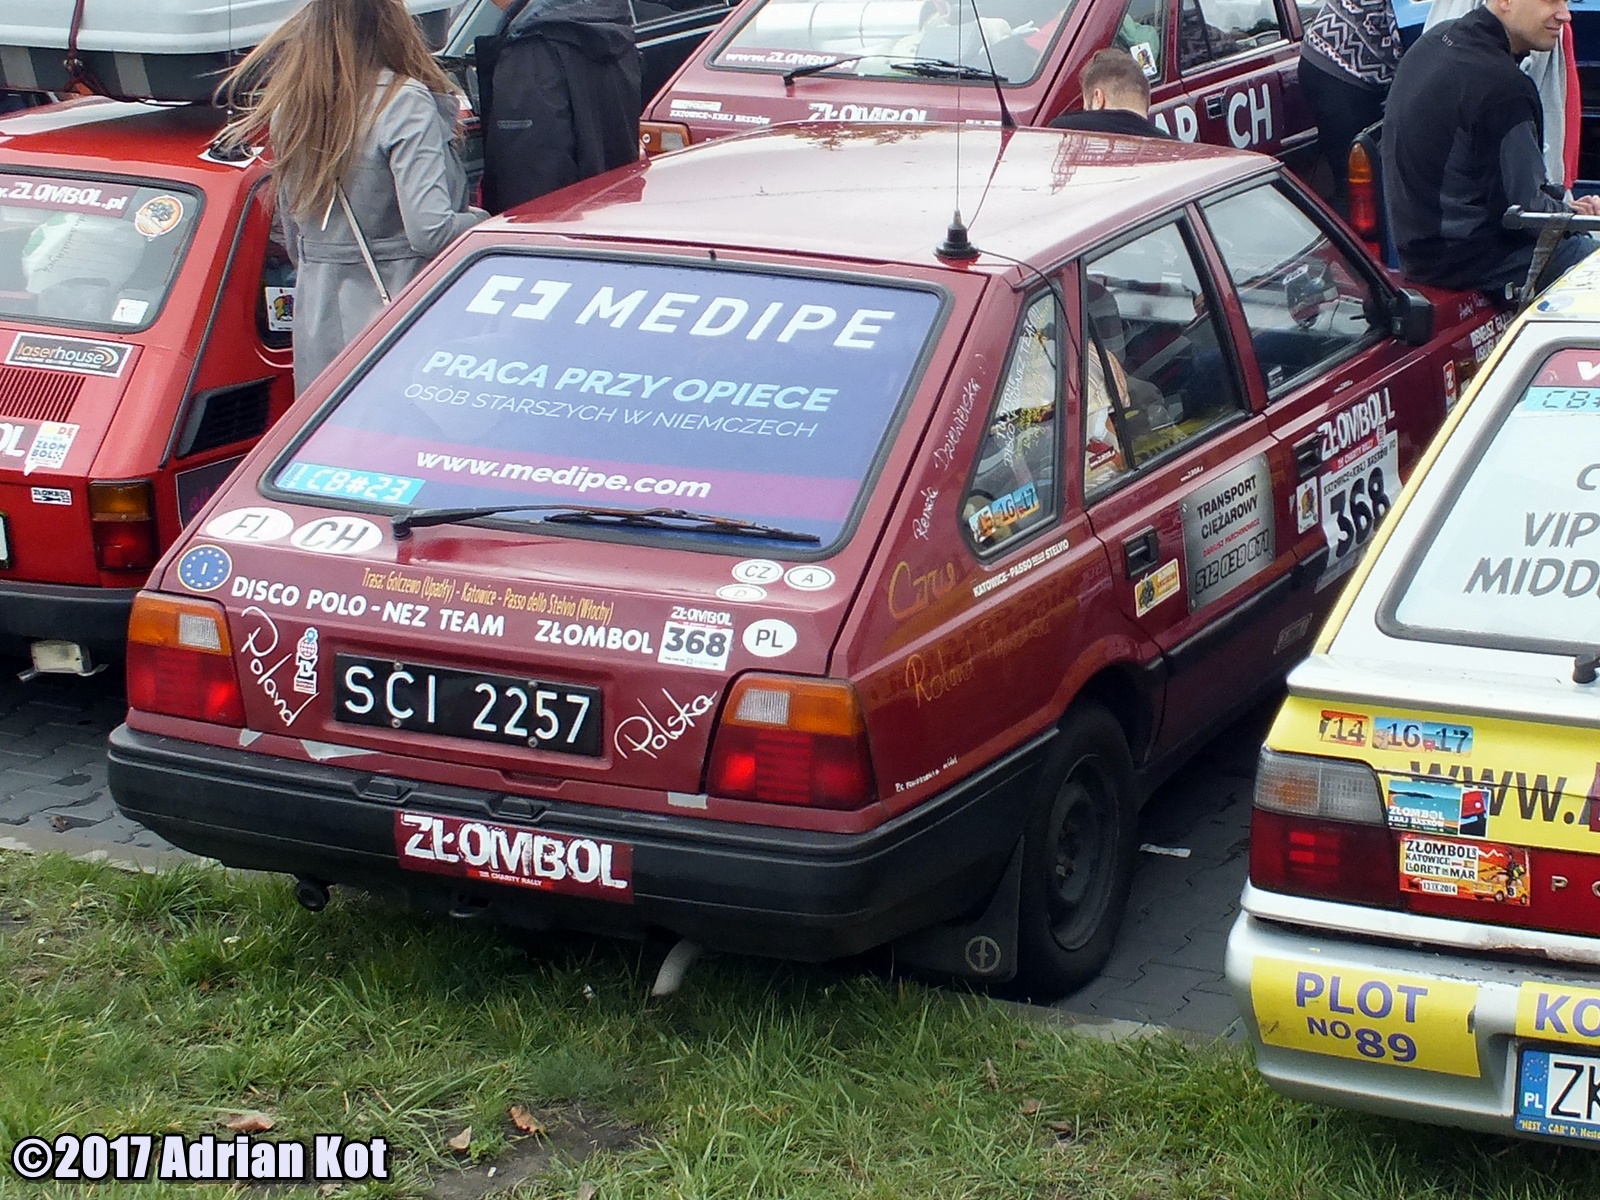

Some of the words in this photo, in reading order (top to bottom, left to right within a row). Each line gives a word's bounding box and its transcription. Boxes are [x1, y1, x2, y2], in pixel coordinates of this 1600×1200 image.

[1228, 83, 1273, 149] CH
[575, 285, 896, 350] MEDIPE
[17, 342, 105, 364] laserhouse
[421, 350, 554, 388] PRACA
[554, 366, 669, 399] PRZY
[671, 378, 840, 412] OPIECE
[403, 381, 471, 405] OSÓB
[471, 392, 617, 425] STARSZYCH
[623, 408, 654, 426] W
[653, 410, 820, 438] NIEMCZECH
[306, 468, 412, 500] CB#23
[416, 449, 713, 499] www.medipe.com
[1197, 474, 1257, 520] TRANSPORT
[1330, 467, 1391, 558] 368
[225, 513, 269, 540] FL
[1201, 494, 1258, 540] CIĘŻAROWY
[1525, 512, 1600, 548] VIP
[300, 519, 370, 552] CH
[1045, 538, 1070, 560] STELVIO
[744, 565, 772, 579] CZ
[801, 572, 815, 584] A
[1195, 560, 1220, 595] 512
[1463, 556, 1600, 599] MIDD
[231, 576, 299, 606] DISCO
[306, 589, 367, 617] POLO
[382, 601, 430, 628] NEZ
[439, 608, 505, 637] TEAM
[362, 567, 386, 589] Trasa:
[386, 571, 422, 594] Golczewo
[460, 581, 497, 606] Katowice
[503, 588, 526, 610] Passo
[526, 591, 547, 613] dello
[547, 593, 576, 617] Stelvio
[576, 597, 615, 626] (Włochy)
[670, 606, 733, 626] ZŁOMBOL
[534, 619, 654, 654] ZŁOMBOL
[664, 626, 727, 657] 368
[754, 629, 784, 648] PL
[240, 605, 320, 727] Poland
[344, 665, 436, 724] SCI
[472, 682, 591, 745] 2257
[614, 687, 719, 760] Polska
[1387, 721, 1421, 748] 16
[1433, 727, 1470, 754] 17
[1388, 805, 1445, 820] ZŁOMBOL
[401, 813, 628, 889] ZŁOMBOL
[1405, 852, 1451, 866] KATOWICE
[1406, 840, 1477, 860] ZŁOMBOL
[490, 872, 521, 884] CHARITY
[521, 876, 543, 886] RALLY
[1449, 868, 1476, 880] MAR
[1295, 971, 1428, 1024] PLOT
[1306, 1016, 1351, 1040] NO
[1354, 1028, 1418, 1063] 89
[1524, 1092, 1544, 1109] PL
